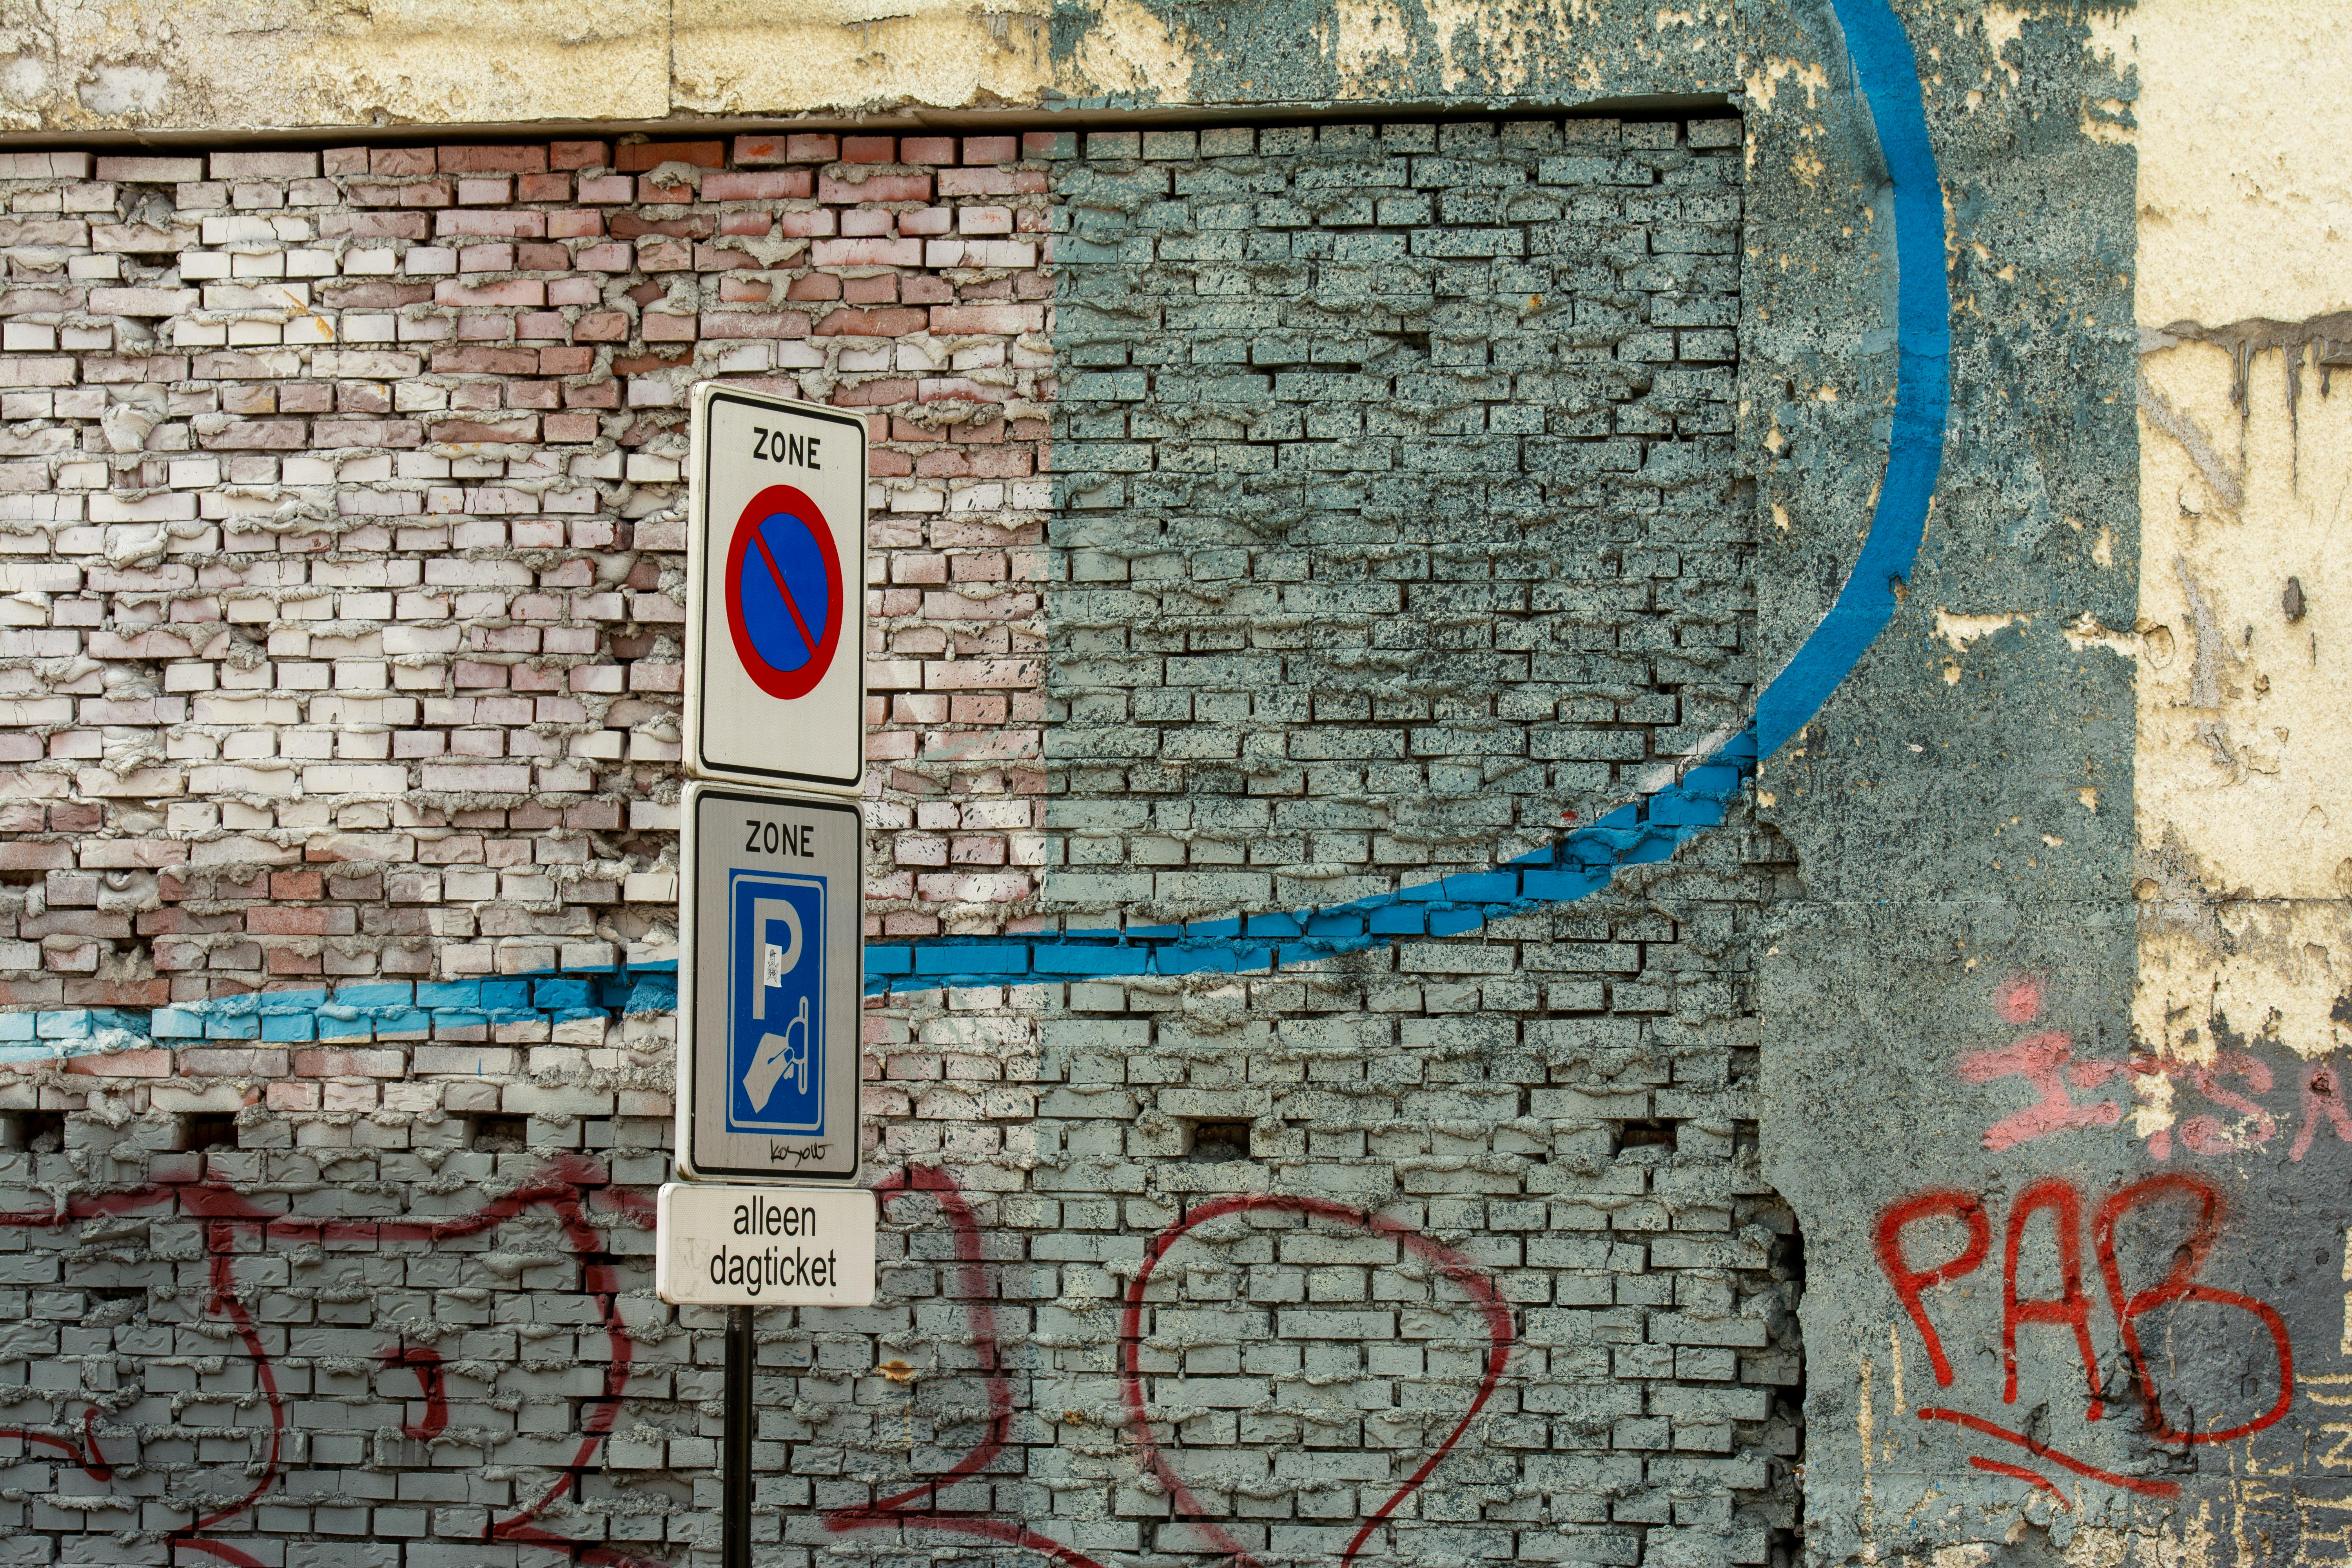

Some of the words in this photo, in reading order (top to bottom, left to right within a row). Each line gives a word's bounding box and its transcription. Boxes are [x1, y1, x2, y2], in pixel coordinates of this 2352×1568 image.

[753, 426, 820, 470] ZONE
[746, 820, 814, 858] ZONE
[753, 897, 803, 1020] P
[733, 1195, 816, 1236] alleen
[710, 1245, 837, 1296] dagticket
